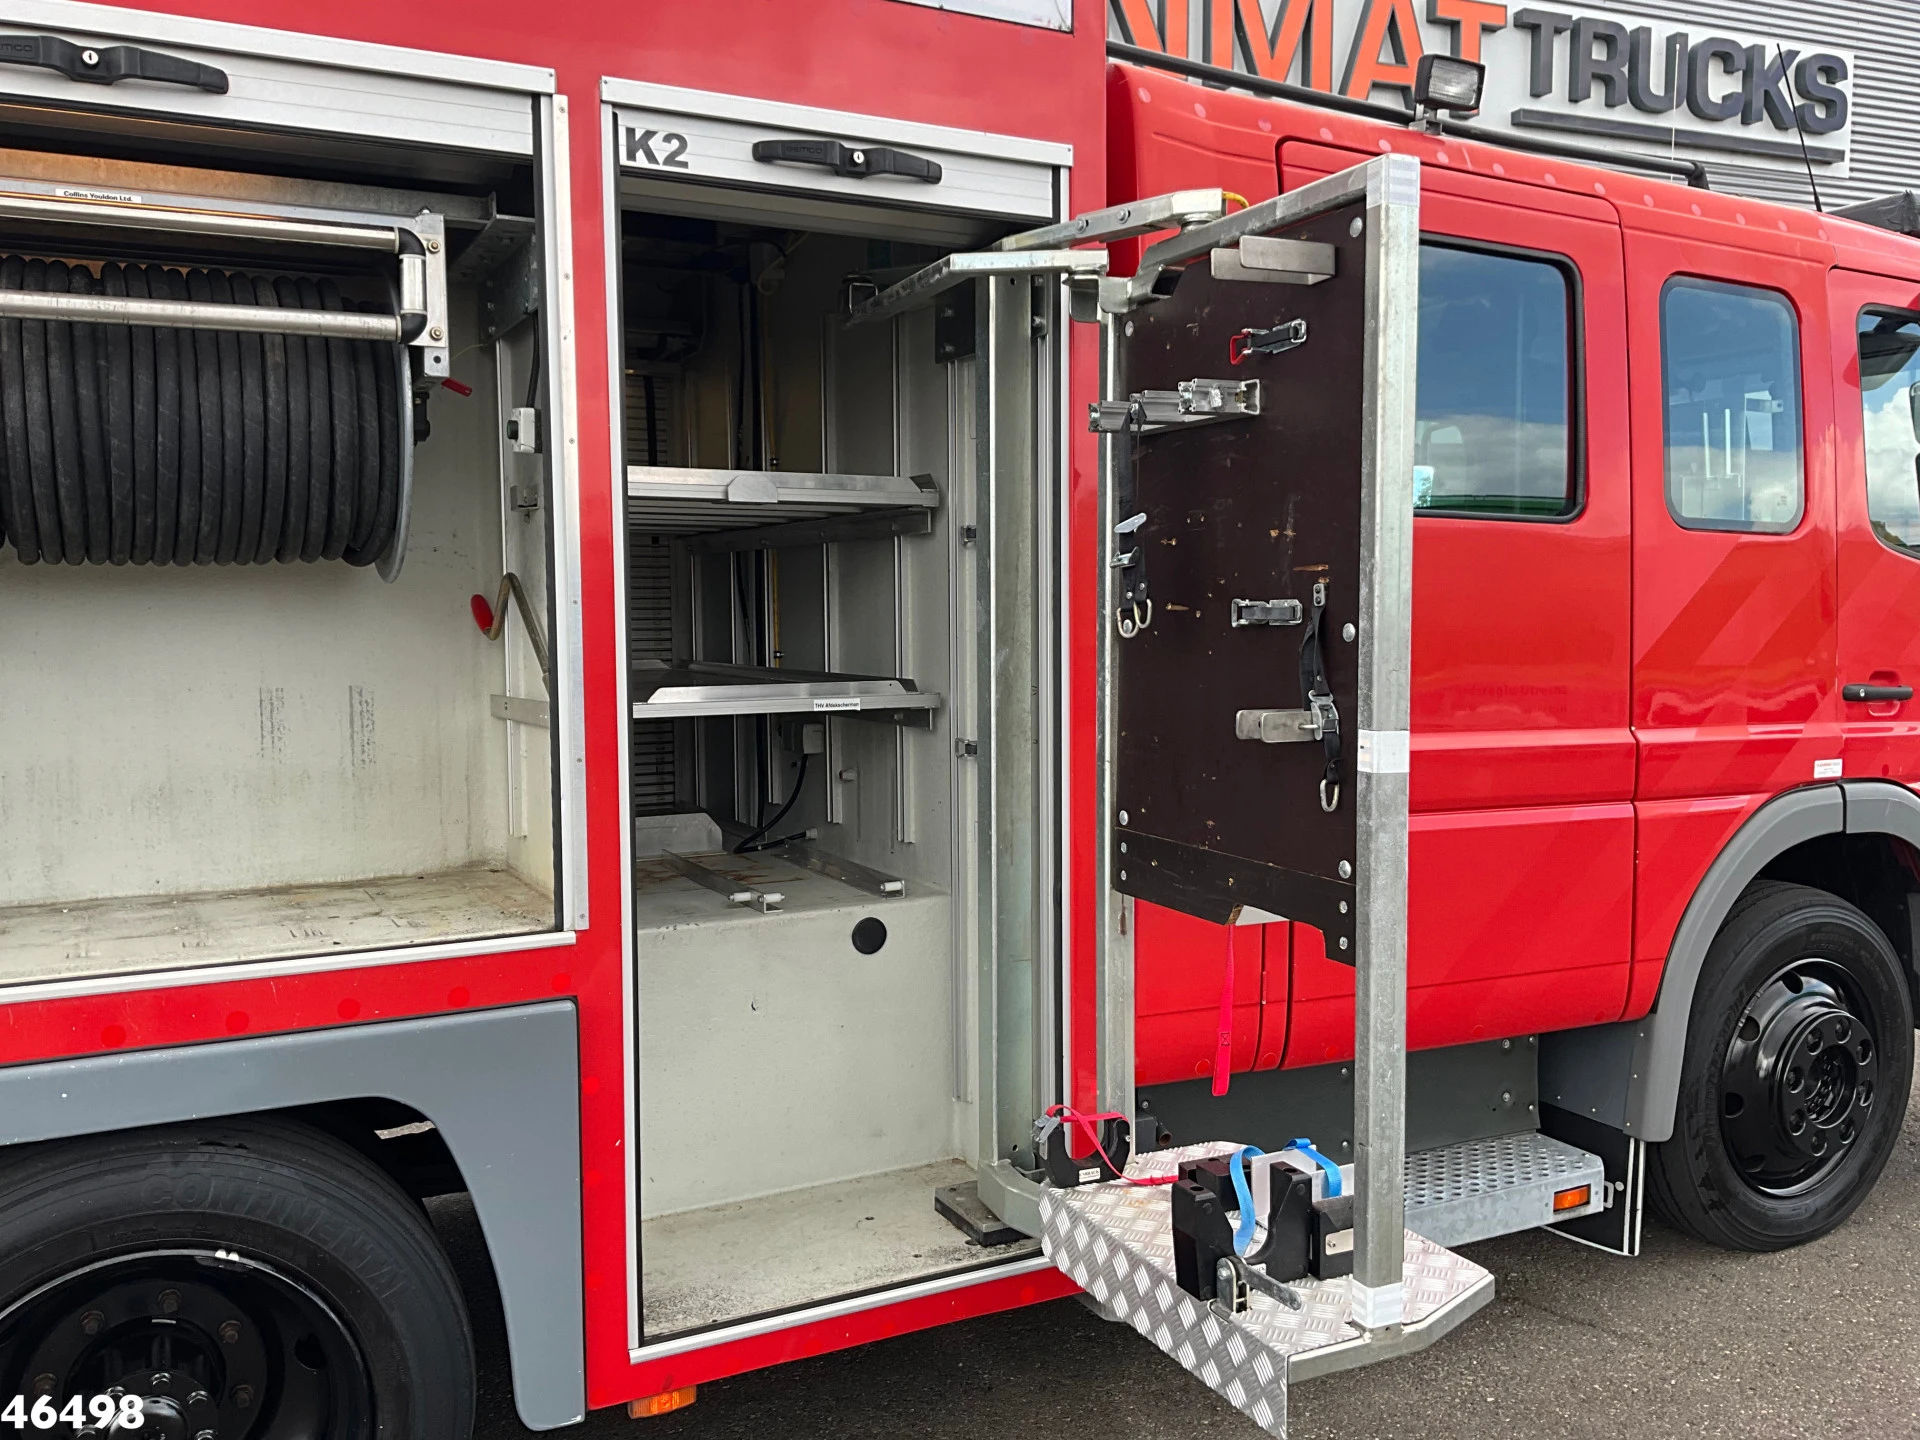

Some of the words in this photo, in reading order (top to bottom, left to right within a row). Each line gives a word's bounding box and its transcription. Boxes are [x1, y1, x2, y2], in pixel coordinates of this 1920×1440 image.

[1514, 8, 1848, 135] TRUCKS
[625, 126, 689, 169] K2
[63, 190, 88, 199] Collins
[90, 193, 118, 201] Youldon
